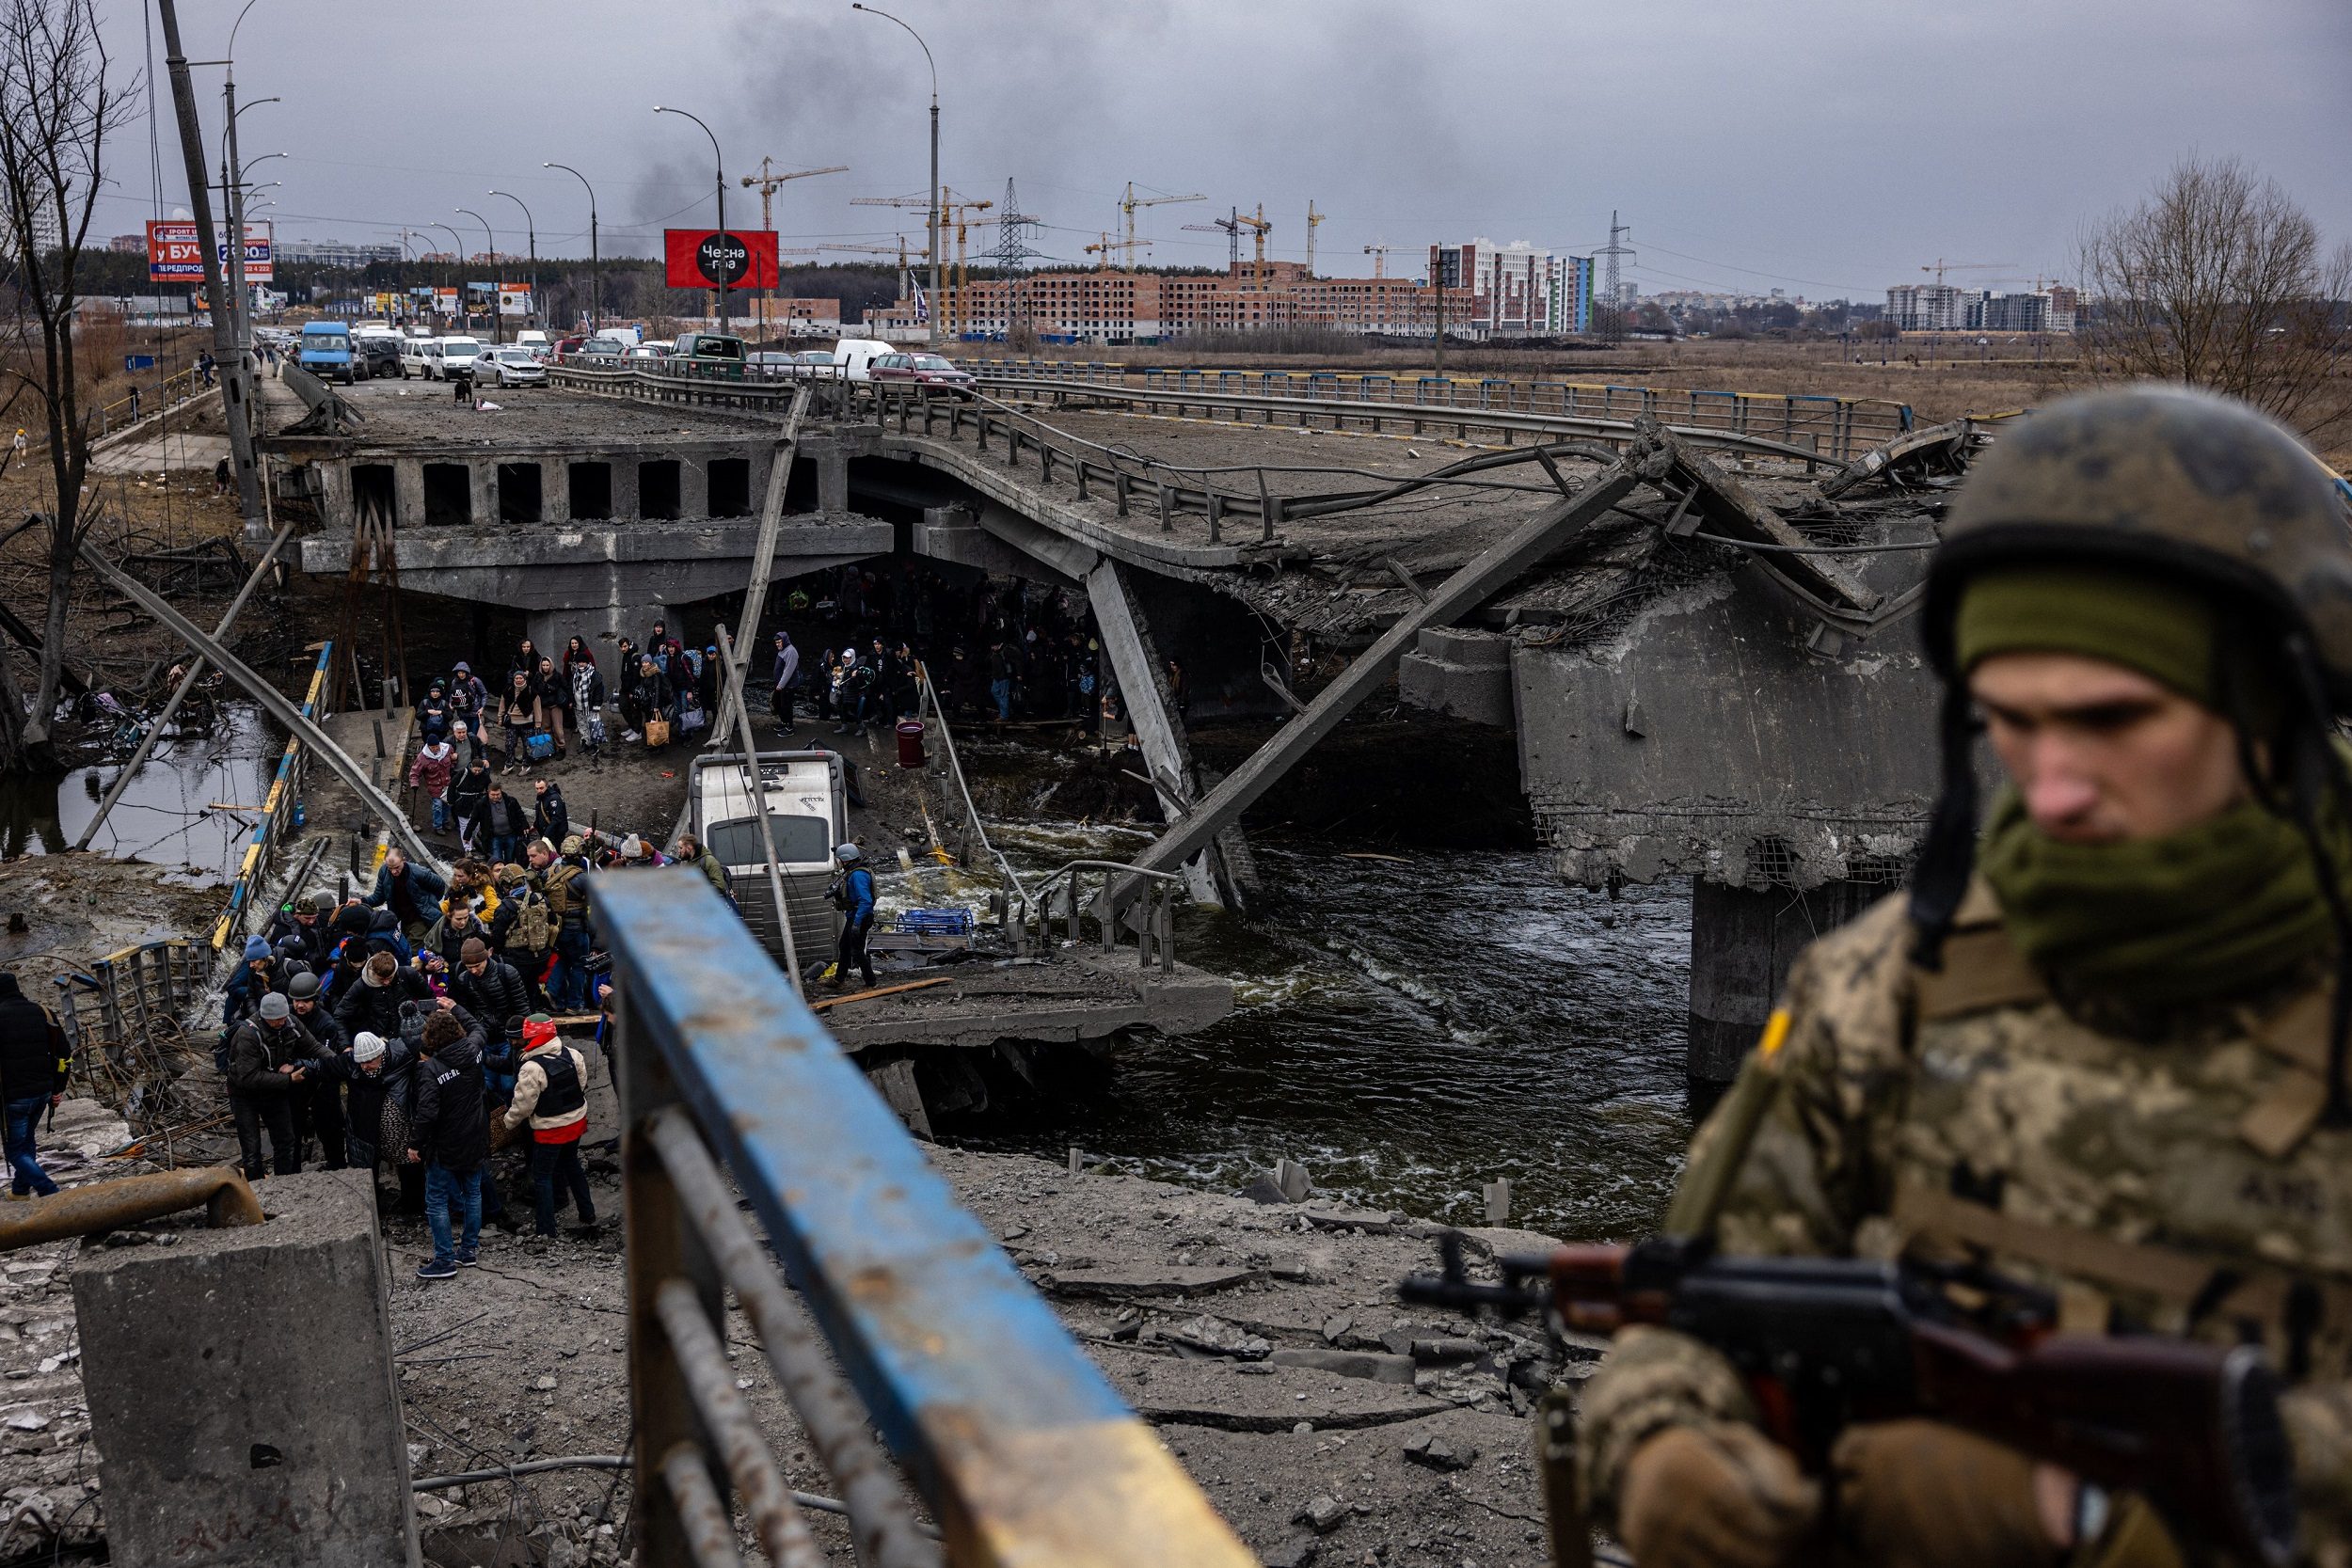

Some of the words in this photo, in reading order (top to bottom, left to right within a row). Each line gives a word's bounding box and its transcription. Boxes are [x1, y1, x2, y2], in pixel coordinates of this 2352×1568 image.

[170, 245, 202, 260] БУЧ
[703, 245, 745, 259] Чесна
[158, 264, 204, 273] ПЕРЕДПРОД
